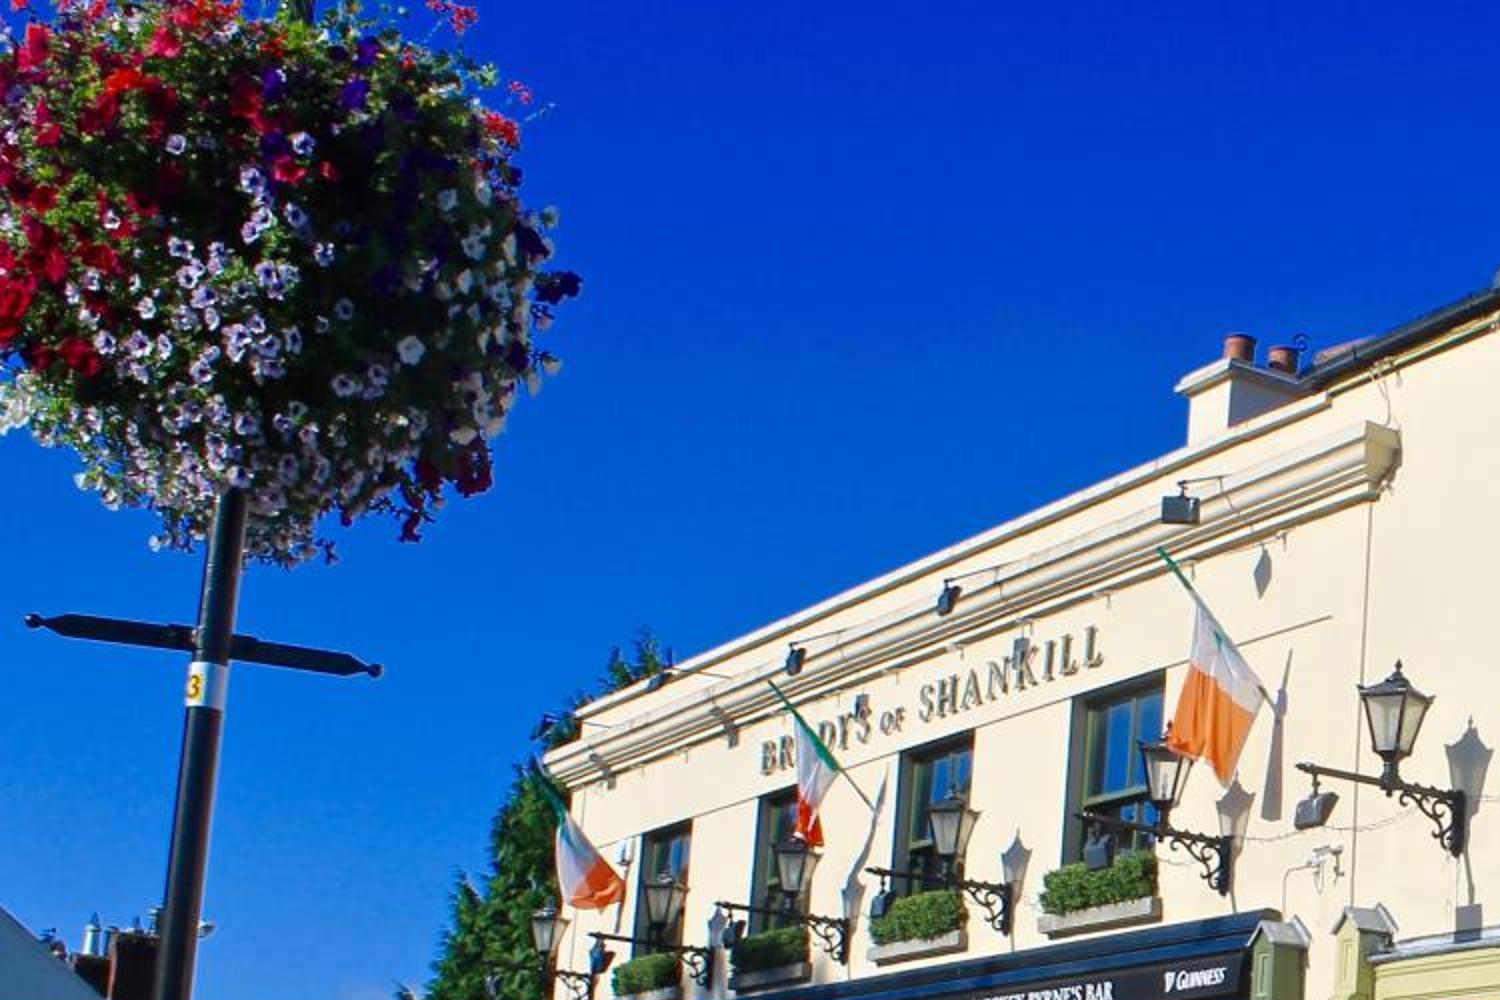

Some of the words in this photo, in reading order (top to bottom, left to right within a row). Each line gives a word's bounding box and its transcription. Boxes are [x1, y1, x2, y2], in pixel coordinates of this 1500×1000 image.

[186, 673, 202, 700] 3
[760, 693, 872, 776] BRDY'S
[918, 625, 1105, 724] SHANKILL
